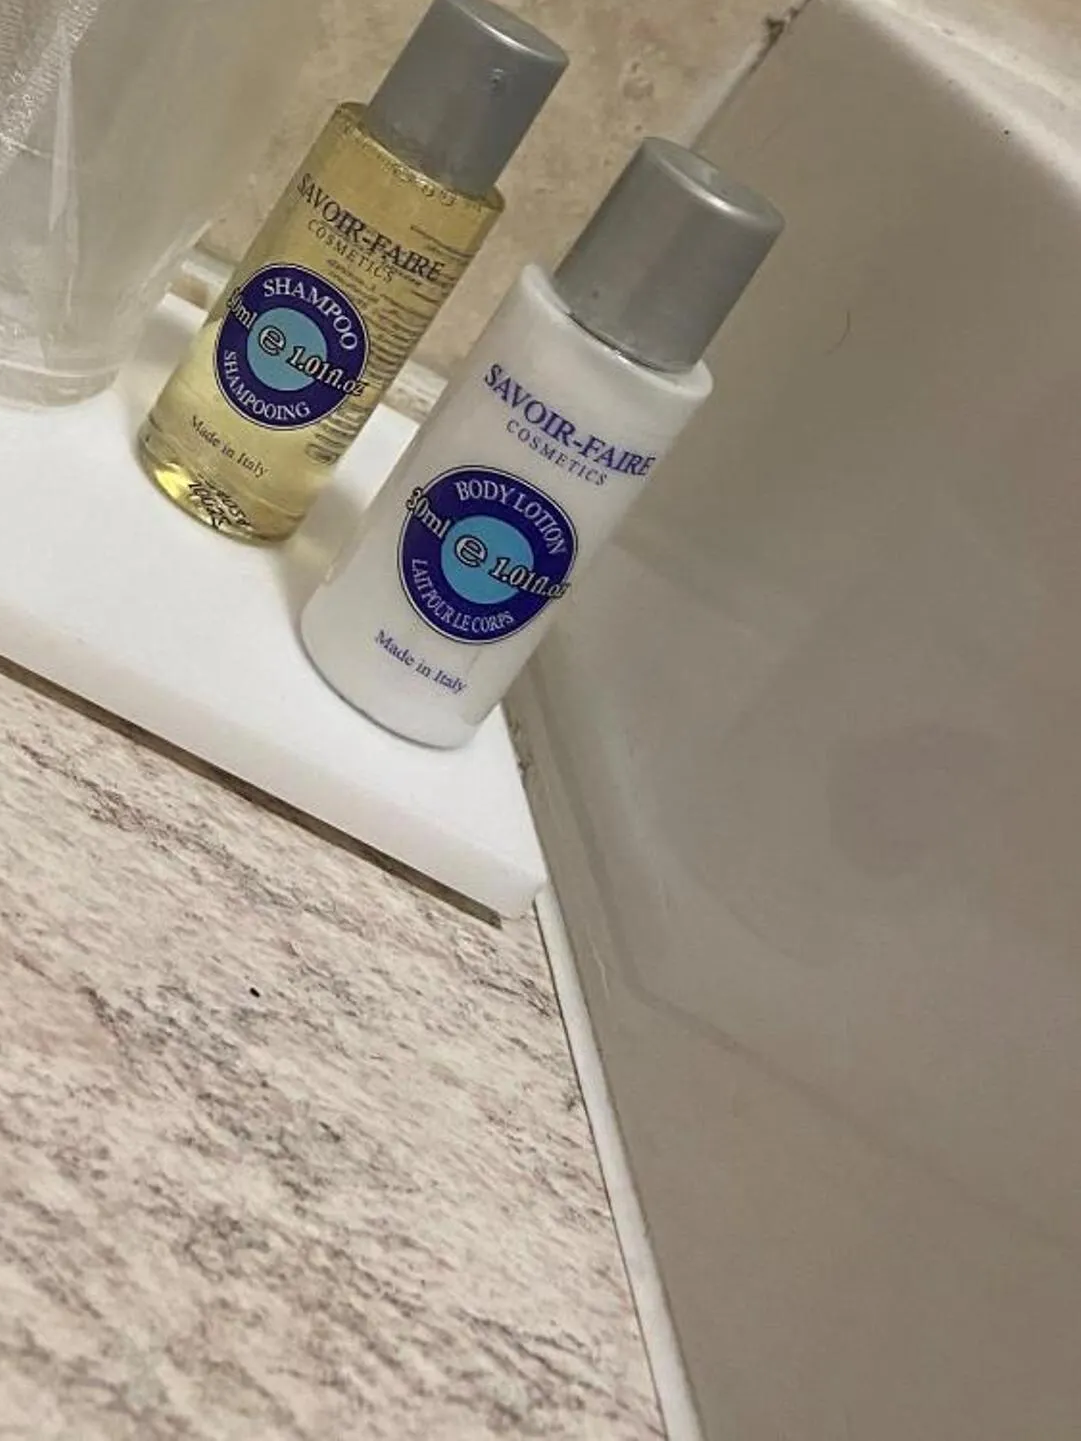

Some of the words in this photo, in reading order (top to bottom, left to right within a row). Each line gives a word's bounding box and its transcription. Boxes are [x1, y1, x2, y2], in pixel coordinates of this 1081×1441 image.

[297, 173, 445, 281] SAVOIR-FAIRE
[308, 219, 395, 283] COSMETICS
[263, 277, 358, 350] SHAMPOO
[224, 351, 311, 420] SHAMPOOING
[485, 364, 656, 476] SAVOIR-FAIRE
[191, 415, 221, 447] Made
[222, 444, 236, 460] in
[236, 452, 269, 478] Italy
[506, 420, 608, 486] COSMETICS
[405, 487, 451, 538] 30ml
[455, 480, 514, 505] BODY
[512, 494, 566, 555] LOTION
[412, 559, 434, 594] LAIT
[423, 591, 454, 625] POUR
[449, 612, 470, 631] LE
[471, 610, 514, 633] CORPS
[375, 629, 415, 666] Made
[416, 663, 431, 678] in
[433, 670, 467, 694] Italy
